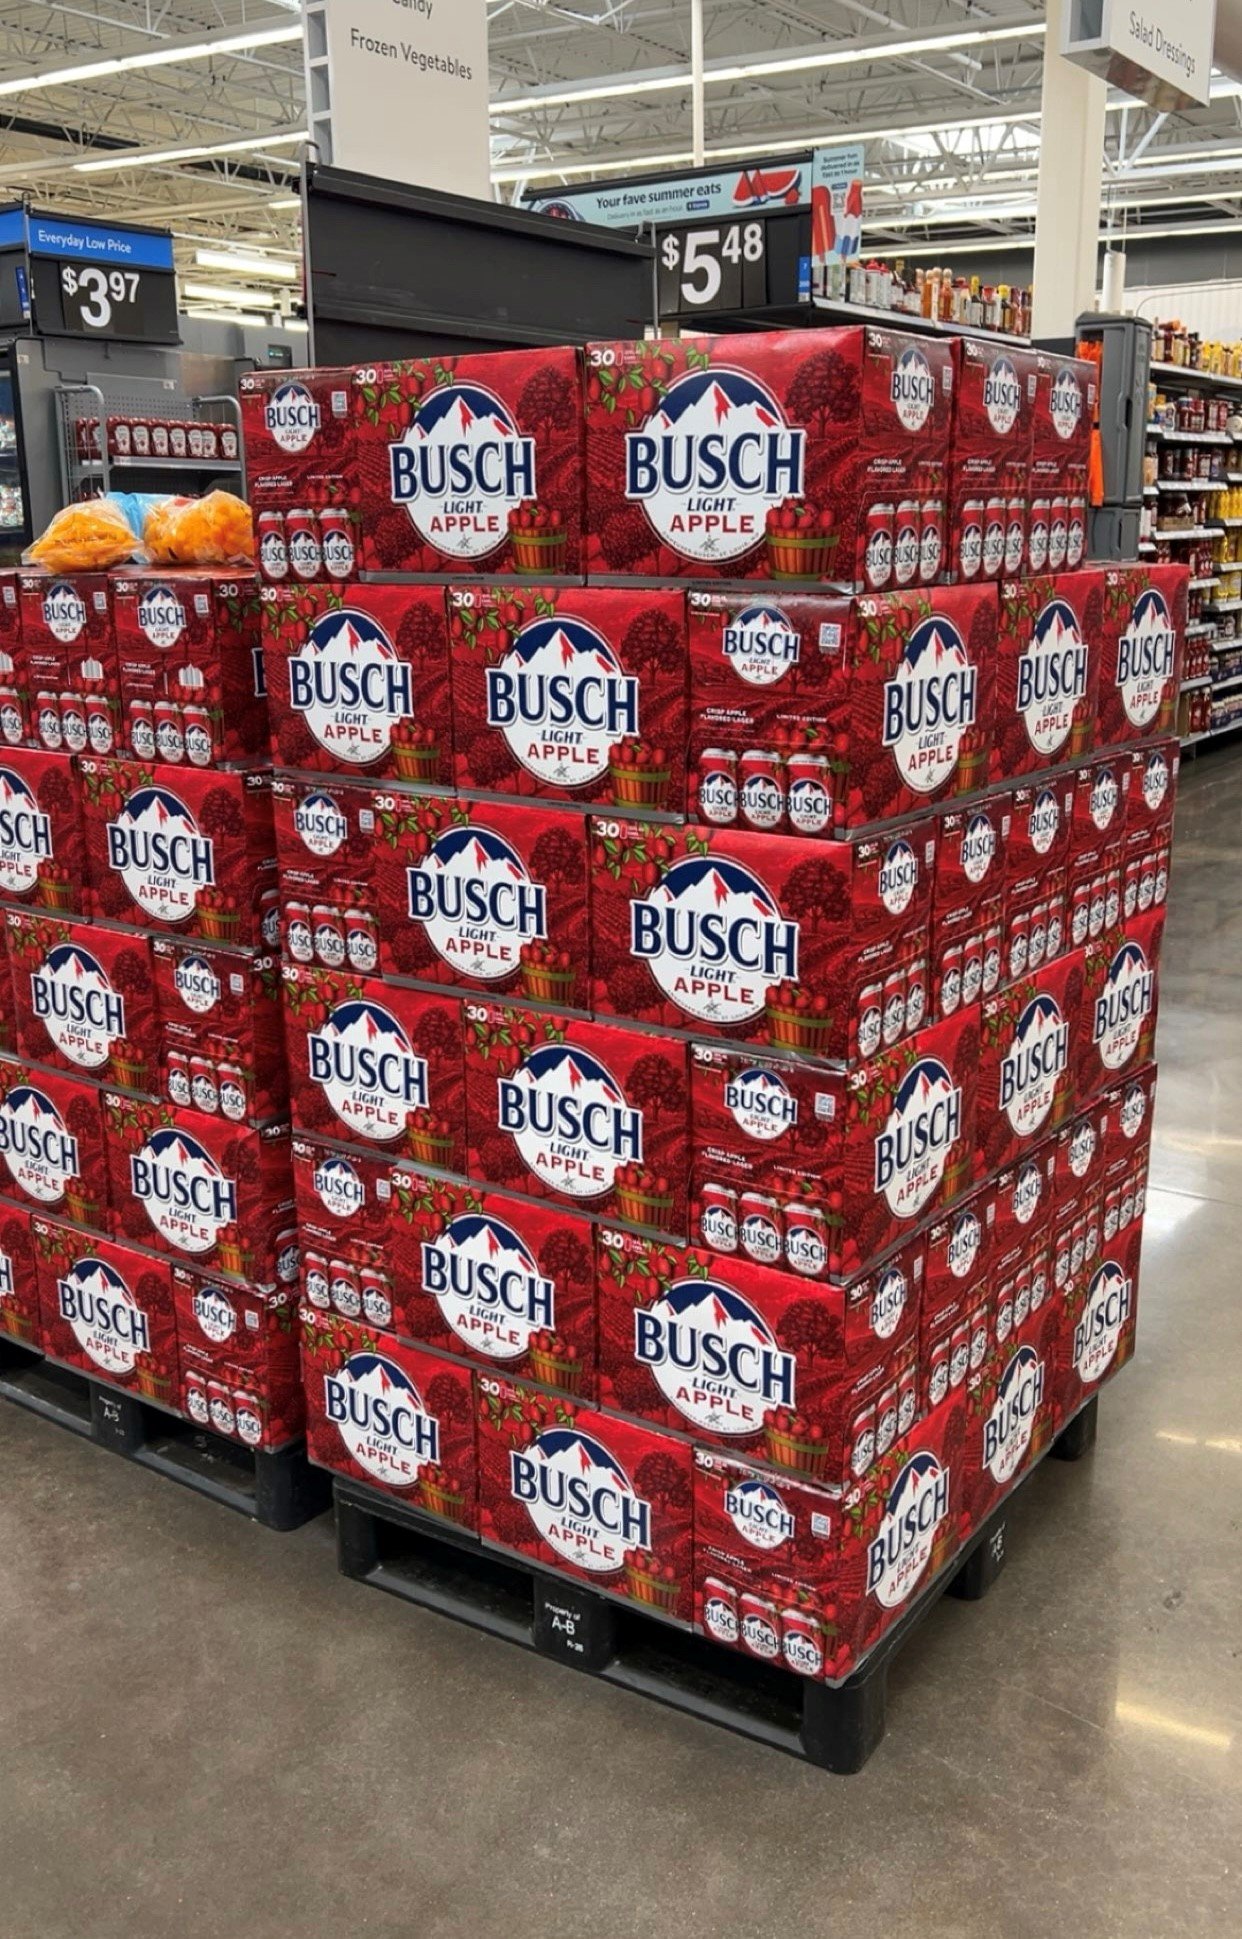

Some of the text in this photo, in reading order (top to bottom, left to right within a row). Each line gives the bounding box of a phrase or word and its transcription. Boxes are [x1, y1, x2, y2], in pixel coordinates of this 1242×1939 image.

[393, 0, 433, 20] andy
[350, 28, 473, 80] Frozen Vegetables
[1129, 10, 1196, 78] Salad Dressings
[596, 182, 722, 209] Your fave summer eats
[38, 230, 131, 254] Everyday Low Price
[590, 350, 615, 366] 30
[356, 369, 377, 384] 30
[892, 373, 934, 404] BUSCH
[984, 380, 1020, 408] BUSCH
[1051, 391, 1081, 416] BUSCH
[266, 404, 319, 428] BUSCH
[391, 441, 534, 499] BUSCH
[627, 431, 803, 494] BUSCH
[444, 500, 483, 514] LIGHT
[687, 497, 736, 512] LIGHT
[430, 516, 499, 533] APPLE
[670, 514, 754, 533] APPLE
[1107, 572, 1118, 586] 30
[261, 588, 276, 600] 30
[452, 592, 474, 607] 30
[1004, 584, 1017, 598] 30
[44, 602, 85, 622] BUSCH
[139, 607, 185, 626] BUSCH
[860, 602, 877, 618] 30
[724, 629, 799, 661] BUSCH
[741, 663, 778, 675] APPLE
[1117, 632, 1175, 685] BUSCH
[290, 659, 411, 715] BUSCH
[1017, 647, 1088, 710] BUSCH
[1137, 680, 1154, 694] LIGHT
[488, 671, 637, 733] BUSCH
[884, 668, 977, 744] BUSCH
[1042, 702, 1063, 717] LIGHT
[1130, 692, 1159, 710] APPLE
[334, 714, 369, 725] LIGHT
[1034, 713, 1069, 736] APPLE
[324, 725, 382, 744] APPLE
[541, 729, 583, 745] LIGHT
[917, 731, 946, 748] LIGHT
[527, 744, 600, 765] APPLE
[908, 745, 953, 771] APPLE
[81, 761, 97, 772] 30
[375, 796, 395, 810] 30
[0, 810, 51, 855] SCH
[296, 813, 346, 837] BUSCH
[596, 821, 619, 837] 30
[109, 826, 213, 883] BUSCH
[0, 862, 31, 877] PPLE
[880, 861, 917, 893] BUSCH
[147, 875, 176, 888] LIGHT
[138, 885, 190, 906] APPLE
[409, 869, 545, 936] BUSCH
[8, 915, 21, 926] 30
[459, 926, 497, 942] LIGHT
[632, 903, 796, 977] BUSCH
[446, 938, 512, 961] APPLE
[1084, 944, 1094, 957] 30
[175, 970, 220, 997] BUSCH
[282, 966, 299, 980] 30
[690, 965, 737, 984] LIGHT
[674, 977, 754, 1005] APPLE
[33, 974, 124, 1036] BUSCH
[467, 1005, 488, 1021] 30
[985, 1001, 998, 1017] 30
[1095, 973, 1152, 1042] BUSCH
[66, 1023, 92, 1039] LIGHT
[59, 1032, 103, 1055] APPLE
[1106, 1031, 1136, 1055] APPLE
[310, 1036, 426, 1105] BUSCH
[1000, 1025, 1068, 1109] BUSCH
[851, 1070, 867, 1089] 30
[106, 1094, 120, 1107] 30
[352, 1091, 385, 1107] LIGHT
[726, 1086, 797, 1122] BUSCH
[1023, 1083, 1044, 1104] LIGHT
[342, 1100, 399, 1126] APPLE
[1016, 1091, 1050, 1122] APPLE
[500, 1081, 640, 1160] BUSCH
[742, 1117, 778, 1132] APPLE
[550, 1142, 590, 1161] LIGHT
[875, 1090, 961, 1191] BUSCH
[25, 1160, 49, 1175] LIGHT
[535, 1153, 605, 1183] APPLE
[906, 1158, 931, 1182] LIGHT
[18, 1168, 59, 1191] APPLE
[132, 1155, 236, 1220] BUSCH
[315, 1173, 363, 1201] BUSCH
[392, 1173, 411, 1188] 30
[897, 1165, 939, 1201] APPLE
[168, 1208, 196, 1223] LIGHT
[35, 1222, 48, 1234] 30
[160, 1215, 209, 1241] APPLE
[603, 1231, 623, 1246] 30
[424, 1245, 552, 1327] BUSCH
[59, 1281, 148, 1349] BUSCH
[193, 1299, 236, 1326] BUSCH
[299, 1309, 316, 1323] 30
[469, 1305, 505, 1323] LIGHT
[1075, 1283, 1130, 1364] BUSCH
[93, 1331, 118, 1347] LIGHT
[457, 1314, 520, 1346] APPLE
[86, 1338, 129, 1363] APPLE
[637, 1313, 792, 1404] BUSCH
[480, 1378, 500, 1394] 30
[692, 1378, 737, 1398] LIGHT
[676, 1387, 754, 1421] APPLE
[985, 1365, 1044, 1465] BUSCH
[327, 1378, 437, 1460] BUSCH
[367, 1436, 398, 1455] LIGHT
[357, 1443, 411, 1475] APPLE
[512, 1452, 650, 1546] BUSCH
[844, 1488, 861, 1511] 30
[726, 1492, 794, 1536] BUSCH
[561, 1517, 598, 1538] LIGHT
[868, 1471, 949, 1592] BUSCH
[549, 1523, 615, 1561] APPLE
[889, 1547, 927, 1597] APPLE
[551, 1615, 576, 1636] A-B
